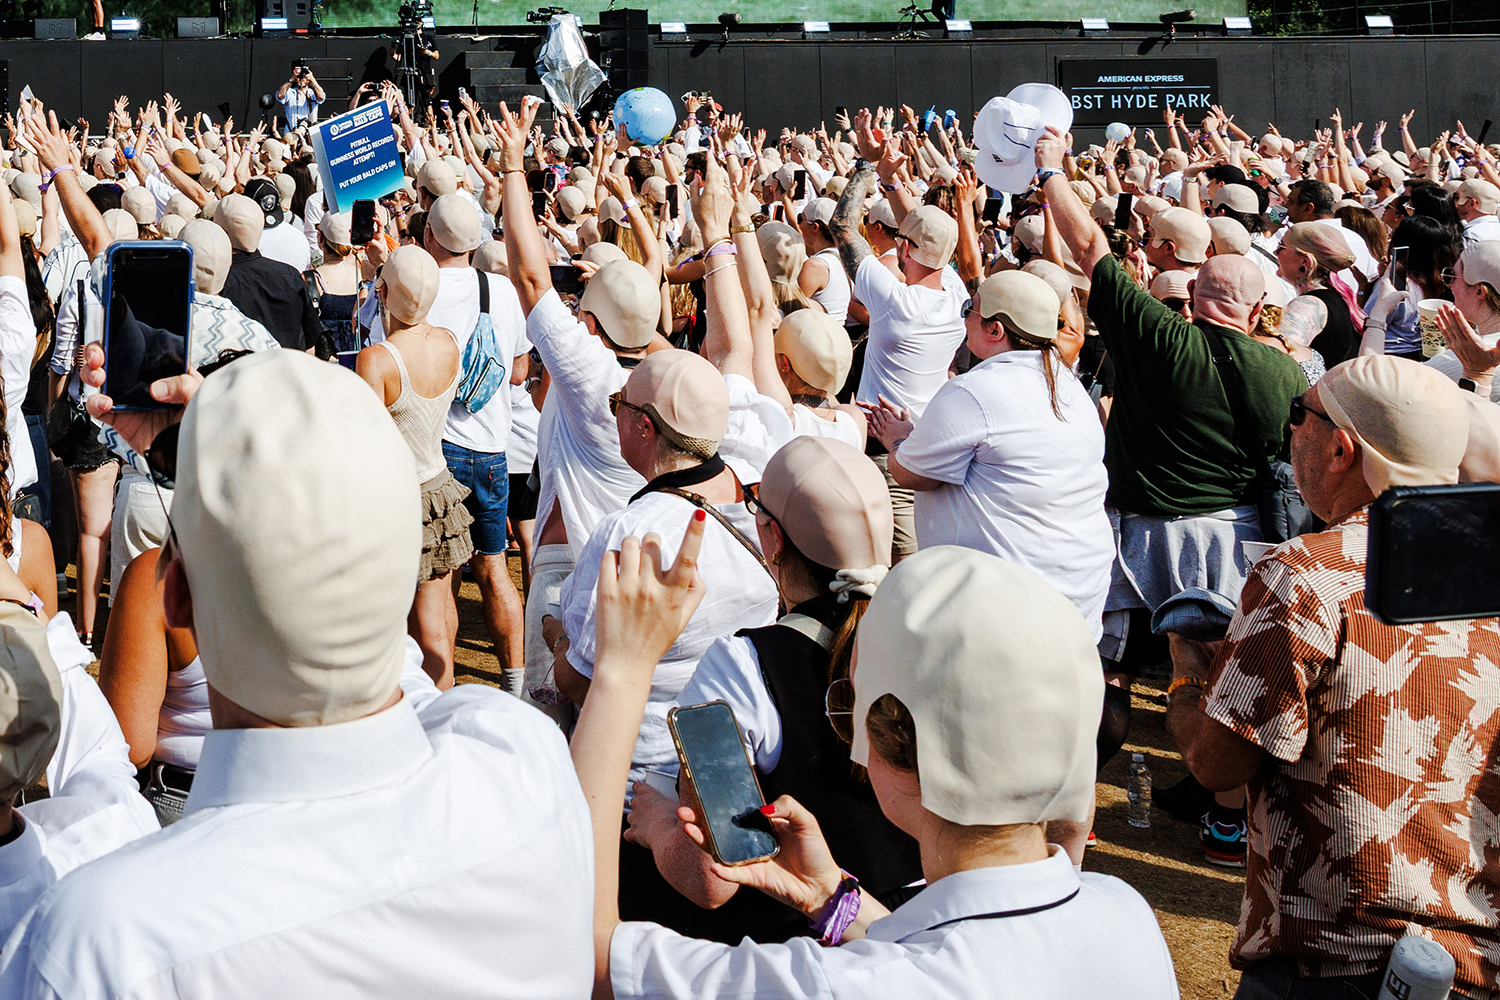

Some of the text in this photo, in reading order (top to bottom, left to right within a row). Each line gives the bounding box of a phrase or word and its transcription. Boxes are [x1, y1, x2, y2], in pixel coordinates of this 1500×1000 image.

[1097, 74, 1184, 83] AMERICAN EXPRESS
[1071, 93, 1211, 109] BST HYDE PARK
[330, 135, 394, 166] GUINNESS WORLD RECORDS
[350, 137, 370, 149] PITBULL
[339, 160, 396, 189] PUT YOUR BALD CAPS ON
